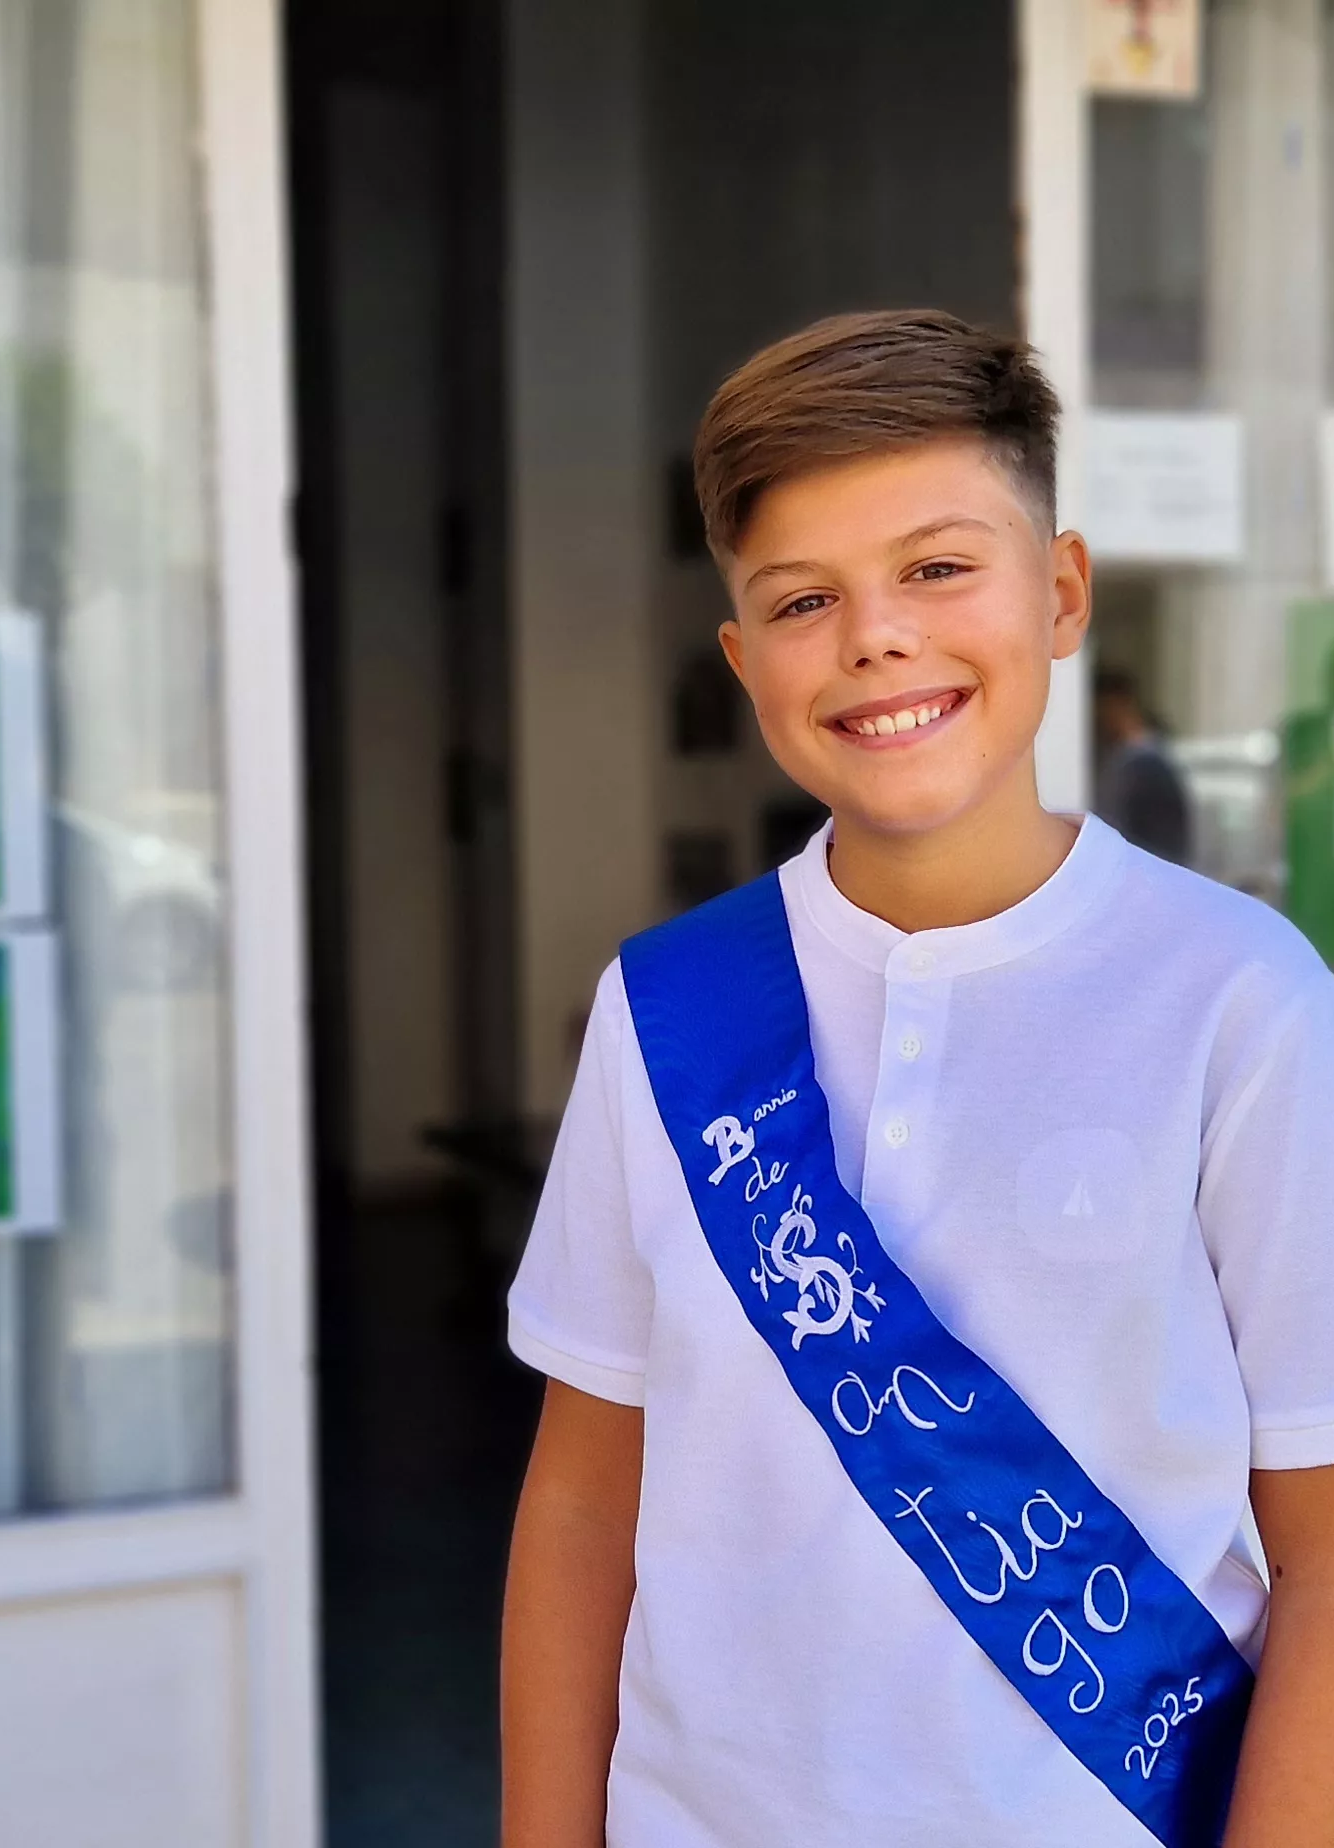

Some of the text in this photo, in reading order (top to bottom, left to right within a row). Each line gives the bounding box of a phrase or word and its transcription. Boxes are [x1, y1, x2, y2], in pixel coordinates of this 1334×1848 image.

[702, 1088, 797, 1185] Barrio
[745, 1156, 789, 1202] de
[1124, 1676, 1204, 1779] 2025
